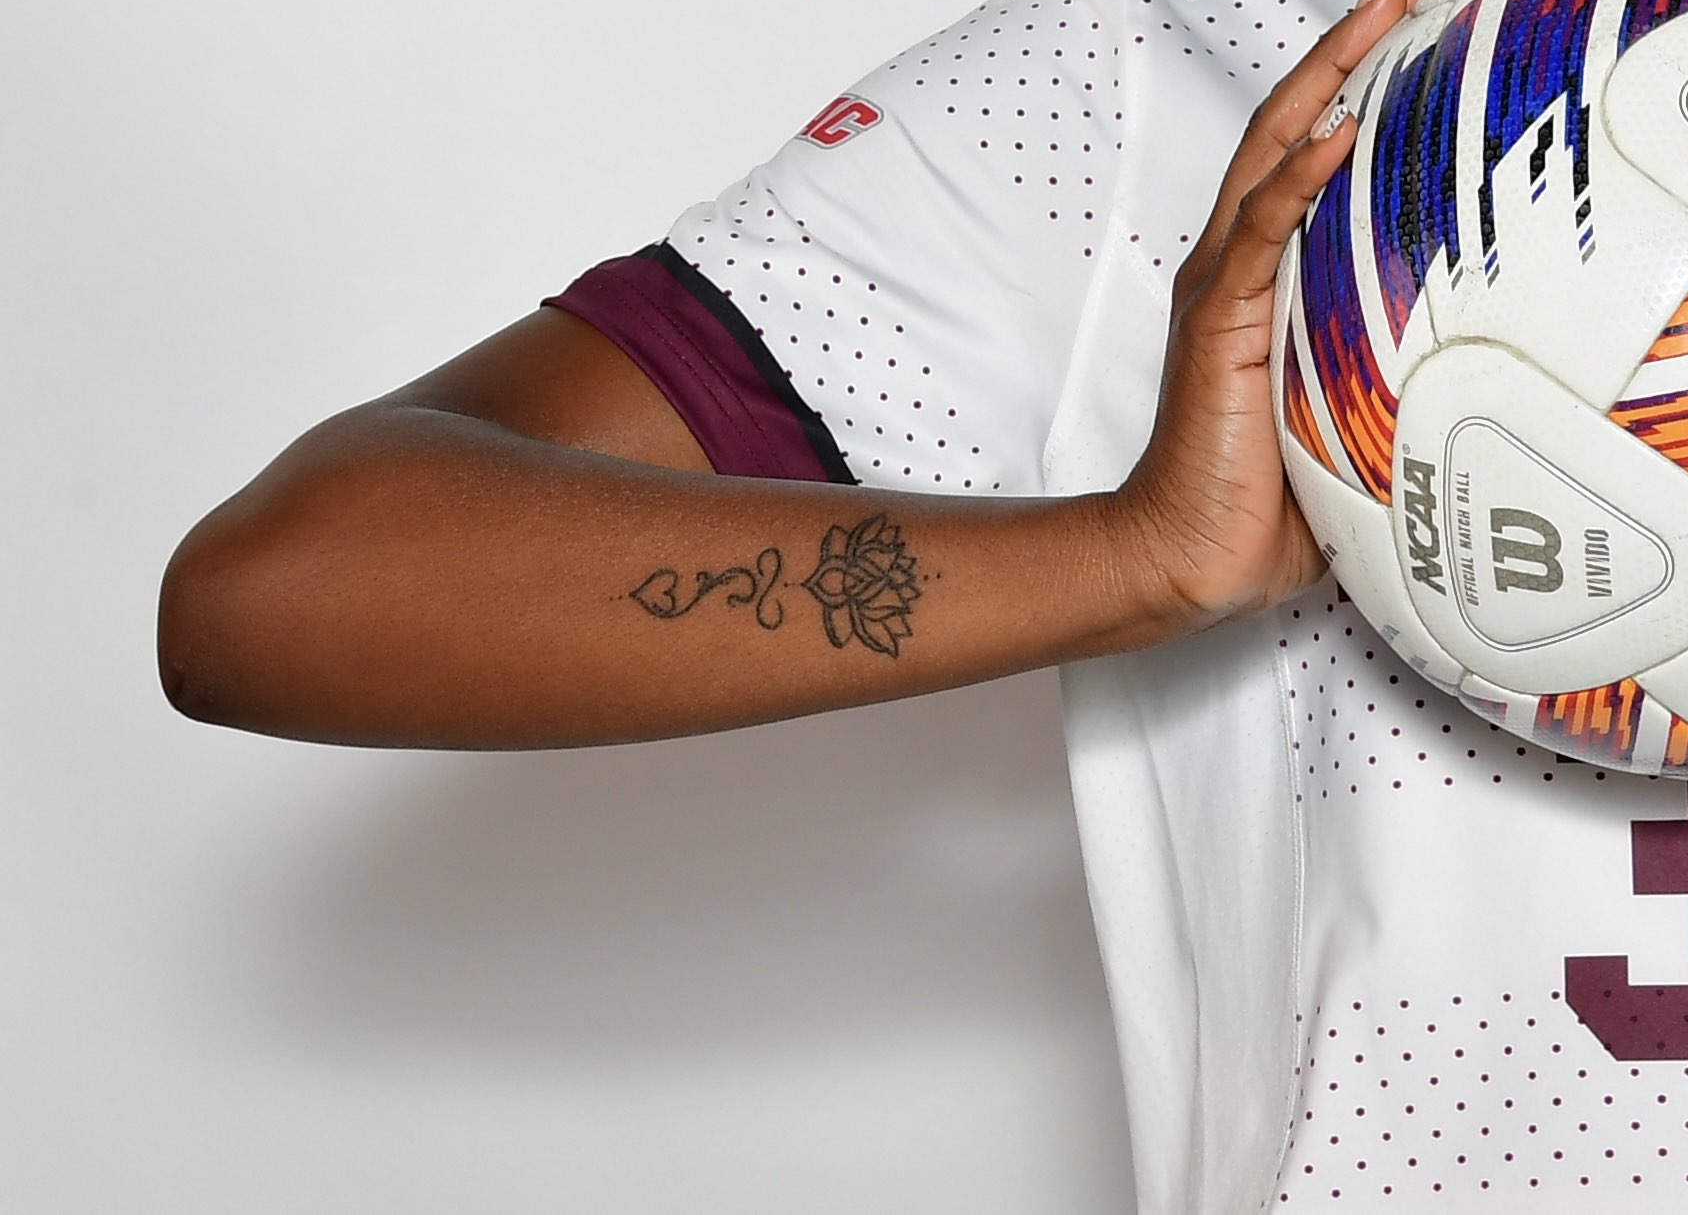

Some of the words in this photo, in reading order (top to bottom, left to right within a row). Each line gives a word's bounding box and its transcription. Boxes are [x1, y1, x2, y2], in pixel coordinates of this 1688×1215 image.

[1455, 471, 1471, 504] BALL
[1457, 508, 1473, 550] MATCH
[1490, 507, 1564, 593] W
[1460, 556, 1480, 607] OFFICIAL
[1584, 528, 1612, 597] VIVIDO
